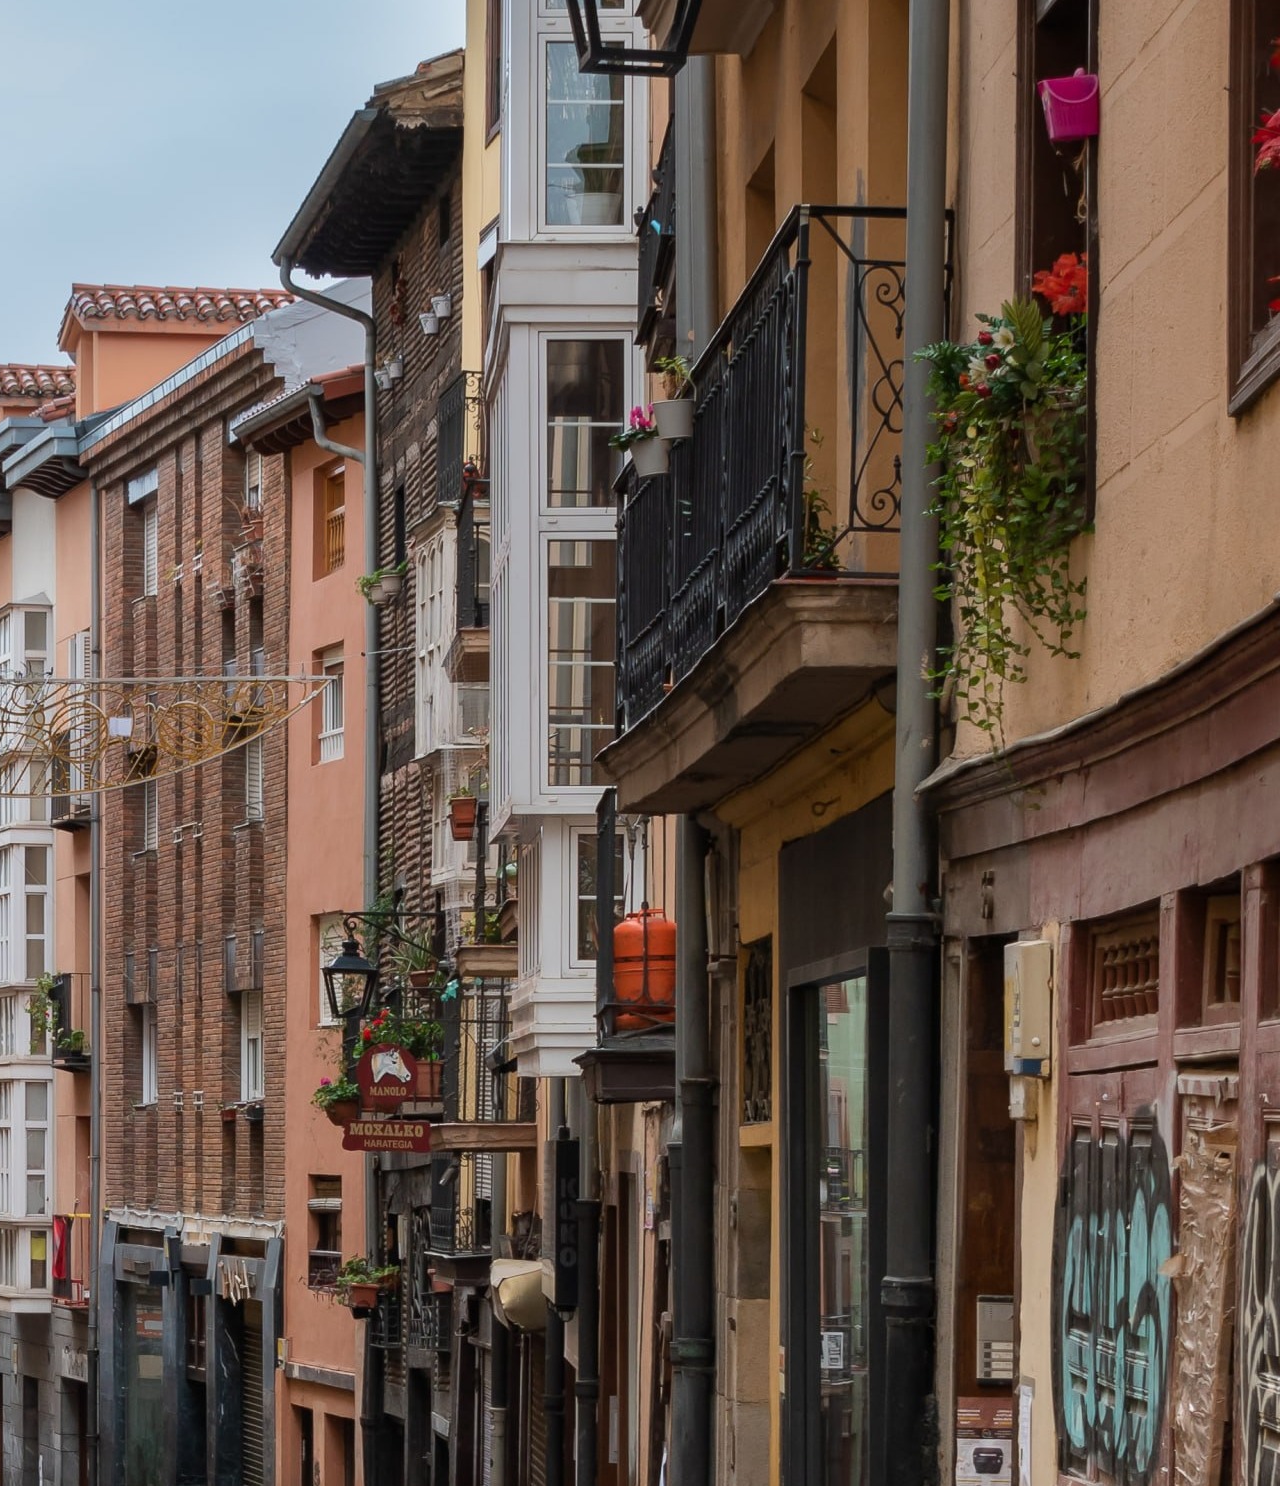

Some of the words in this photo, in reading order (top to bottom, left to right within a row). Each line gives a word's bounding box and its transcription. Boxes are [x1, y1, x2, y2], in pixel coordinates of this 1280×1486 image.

[369, 1086, 407, 1096] MANOLO
[350, 1123, 424, 1138] MOXALKO
[363, 1139, 413, 1149] HARATEGIA
